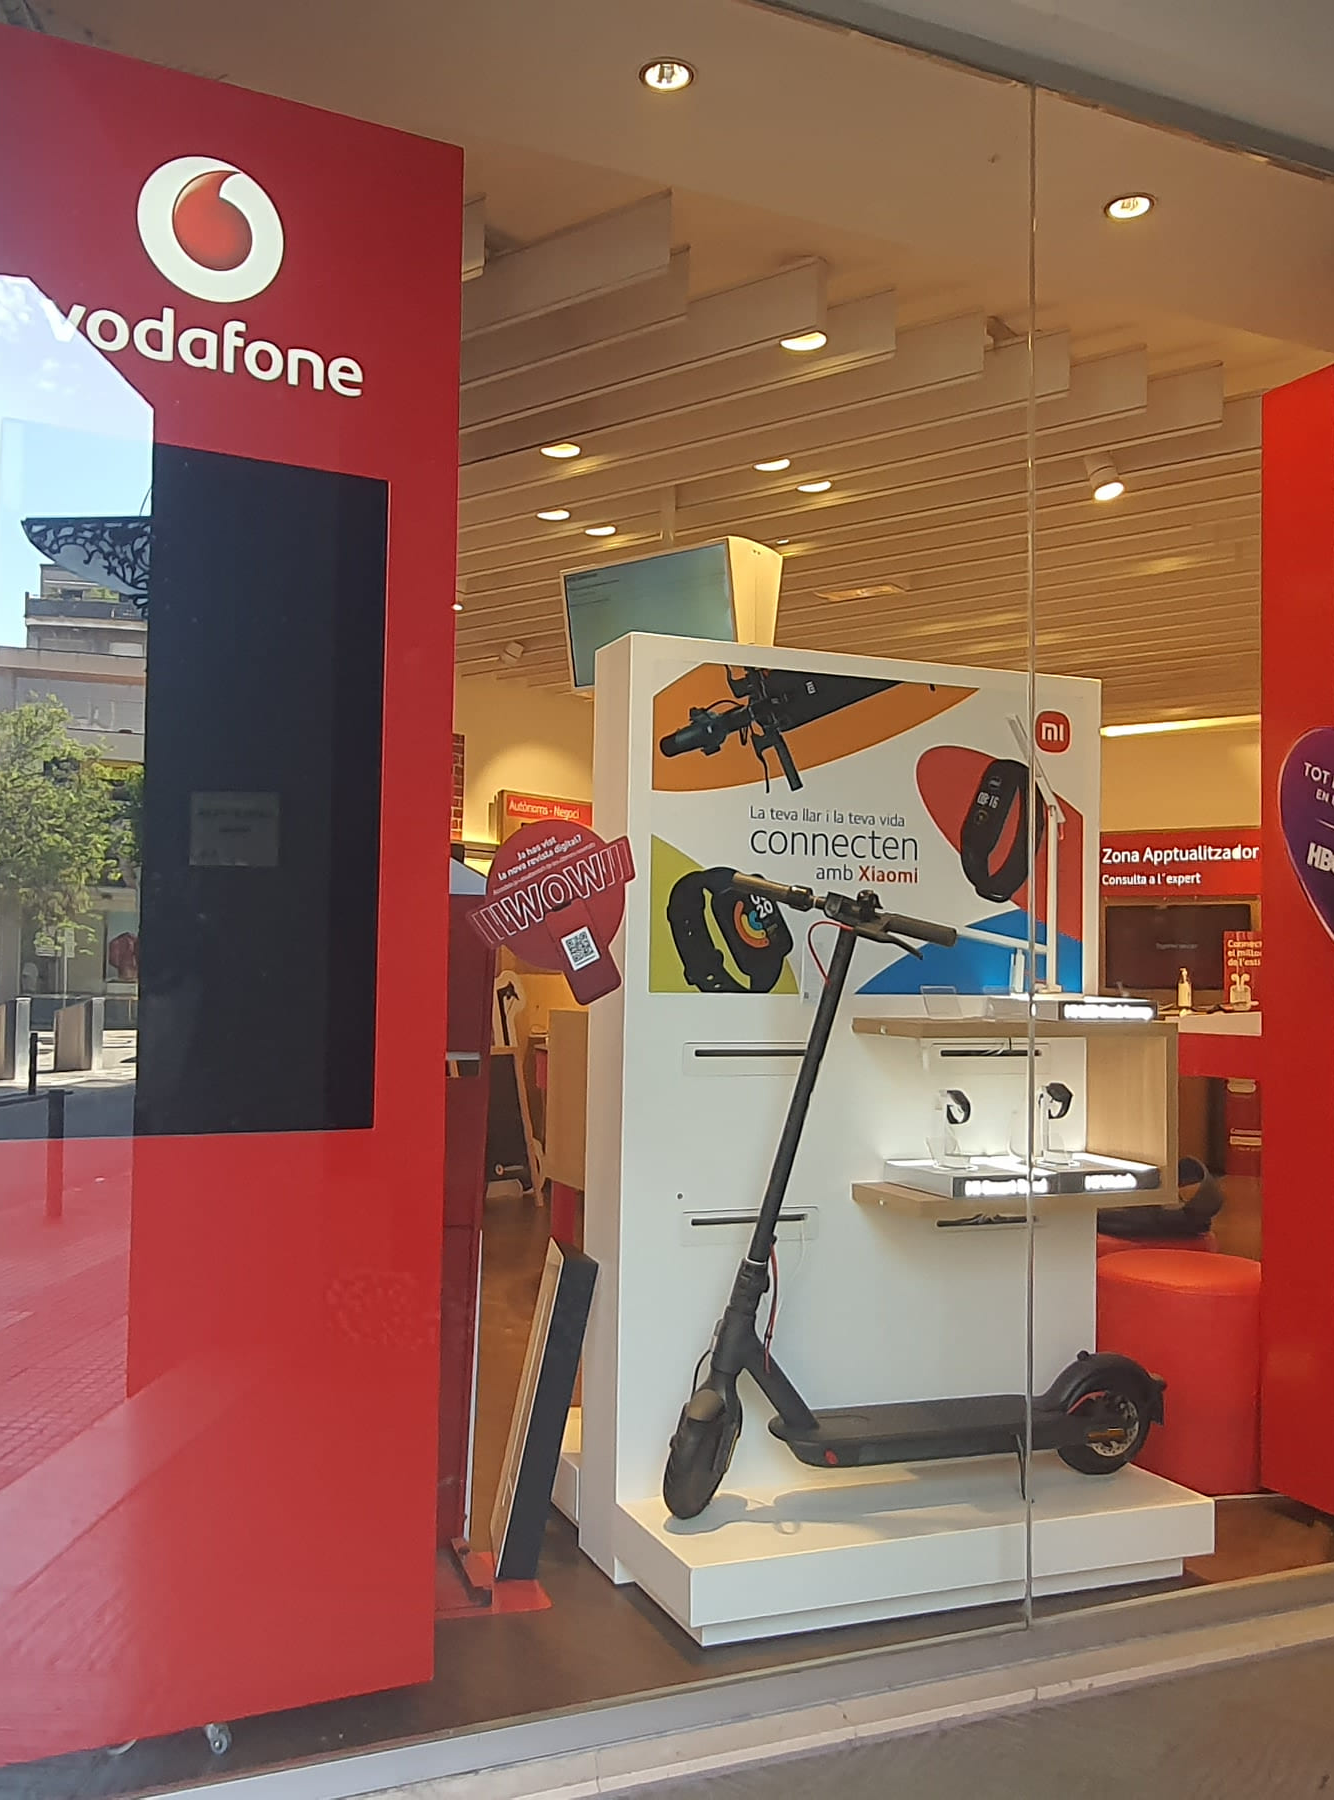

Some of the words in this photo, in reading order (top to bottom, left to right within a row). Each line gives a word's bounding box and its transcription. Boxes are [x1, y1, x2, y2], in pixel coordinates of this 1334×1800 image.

[43, 299, 364, 397] vodafone
[1304, 761, 1331, 785] TOT
[1316, 788, 1329, 803] EN
[749, 805, 765, 820] La
[769, 808, 798, 822] teva
[802, 808, 822, 823] llar
[825, 809, 830, 822] i
[833, 810, 844, 824] la
[848, 812, 875, 826] teva
[879, 813, 905, 827] vida
[750, 829, 918, 861] connecten
[1102, 848, 1140, 864] Zona
[1143, 844, 1260, 866] Apptualitzador
[507, 862, 527, 877] nova
[527, 849, 554, 867] revista
[815, 864, 854, 881] amb
[858, 865, 919, 884] Xiaomi
[1101, 873, 1147, 886] Consulta
[1148, 875, 1155, 885] a
